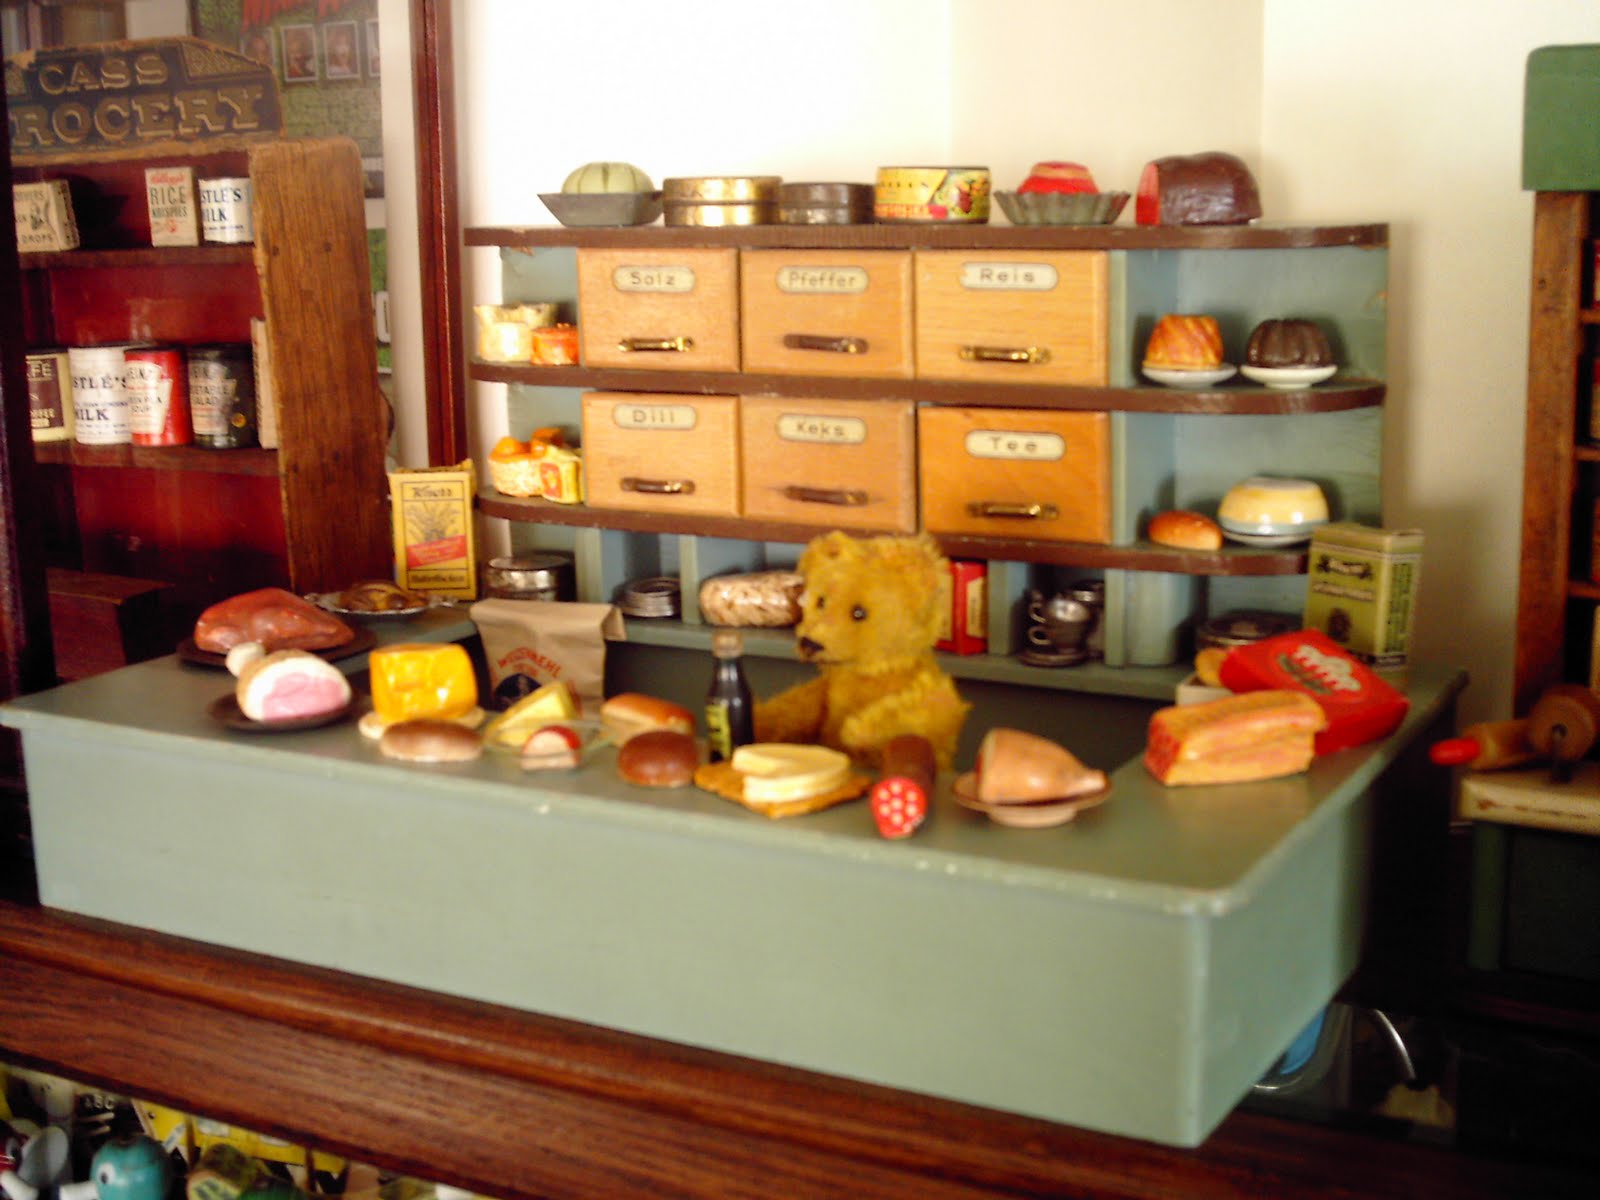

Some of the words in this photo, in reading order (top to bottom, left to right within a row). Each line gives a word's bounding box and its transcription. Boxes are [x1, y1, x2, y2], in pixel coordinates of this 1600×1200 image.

[38, 53, 168, 95] CASS
[150, 186, 186, 206] RICE
[789, 271, 856, 288] Pfeffer
[980, 267, 1035, 283] Reis
[633, 409, 675, 424] Dill
[797, 421, 844, 438] Keks
[990, 436, 1038, 453] Tee
